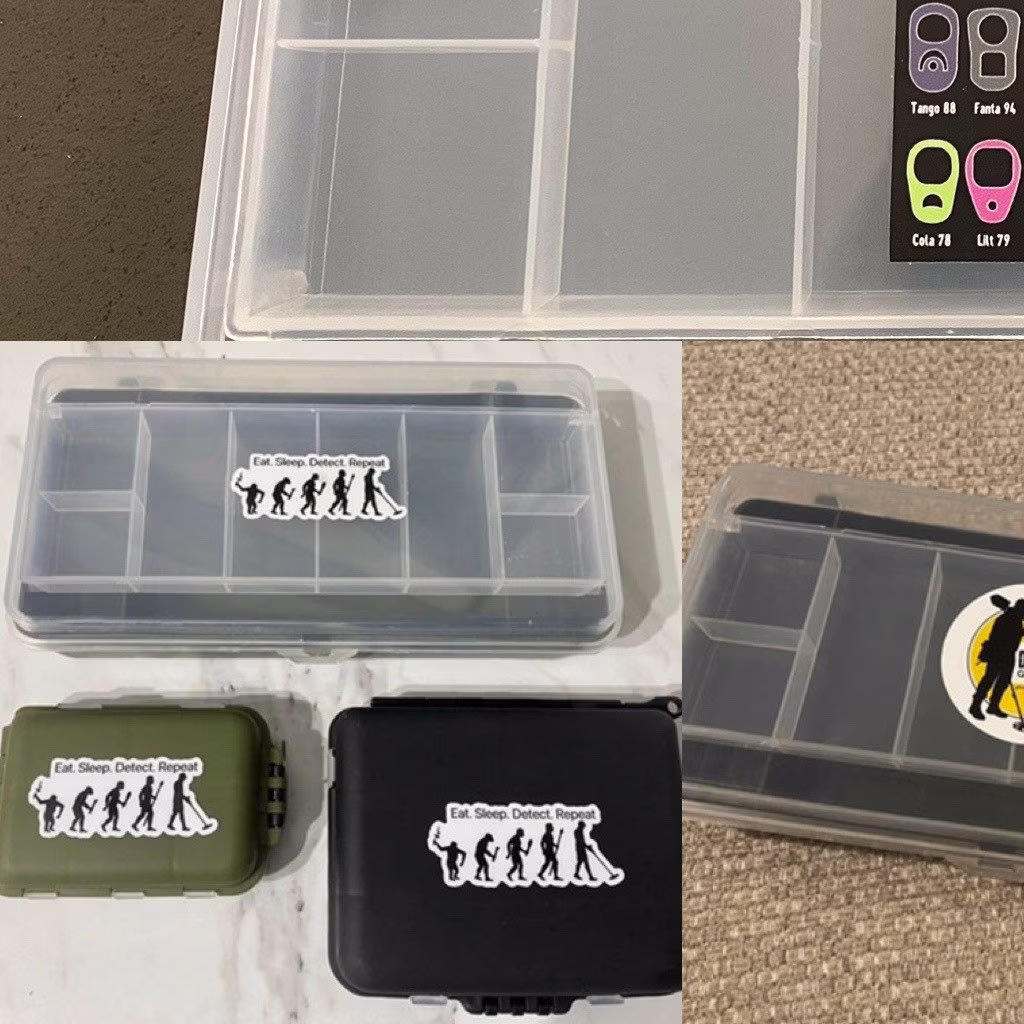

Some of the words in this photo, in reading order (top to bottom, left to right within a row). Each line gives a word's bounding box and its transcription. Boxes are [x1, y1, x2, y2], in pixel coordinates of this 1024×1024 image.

[911, 102, 940, 115] Tango
[943, 102, 956, 114] 88
[974, 102, 1000, 114] Fanta
[1003, 102, 1016, 114] 94
[912, 234, 935, 246] Cola
[937, 234, 951, 246] 78
[977, 234, 994, 246] Lilt
[996, 234, 1010, 246] 79
[254, 457, 272, 466] Eat.
[275, 457, 305, 467] Sleep.
[309, 457, 345, 466] Detect.
[349, 458, 385, 468] Repeat
[55, 763, 74, 773] Eat.
[78, 762, 112, 774] Sleep.
[115, 762, 154, 773] Detect.
[158, 762, 198, 773] Repeat
[451, 808, 471, 818] Eat.
[474, 808, 509, 820] Sleep.
[513, 808, 552, 819] Detect.
[556, 809, 596, 820] Repeat
